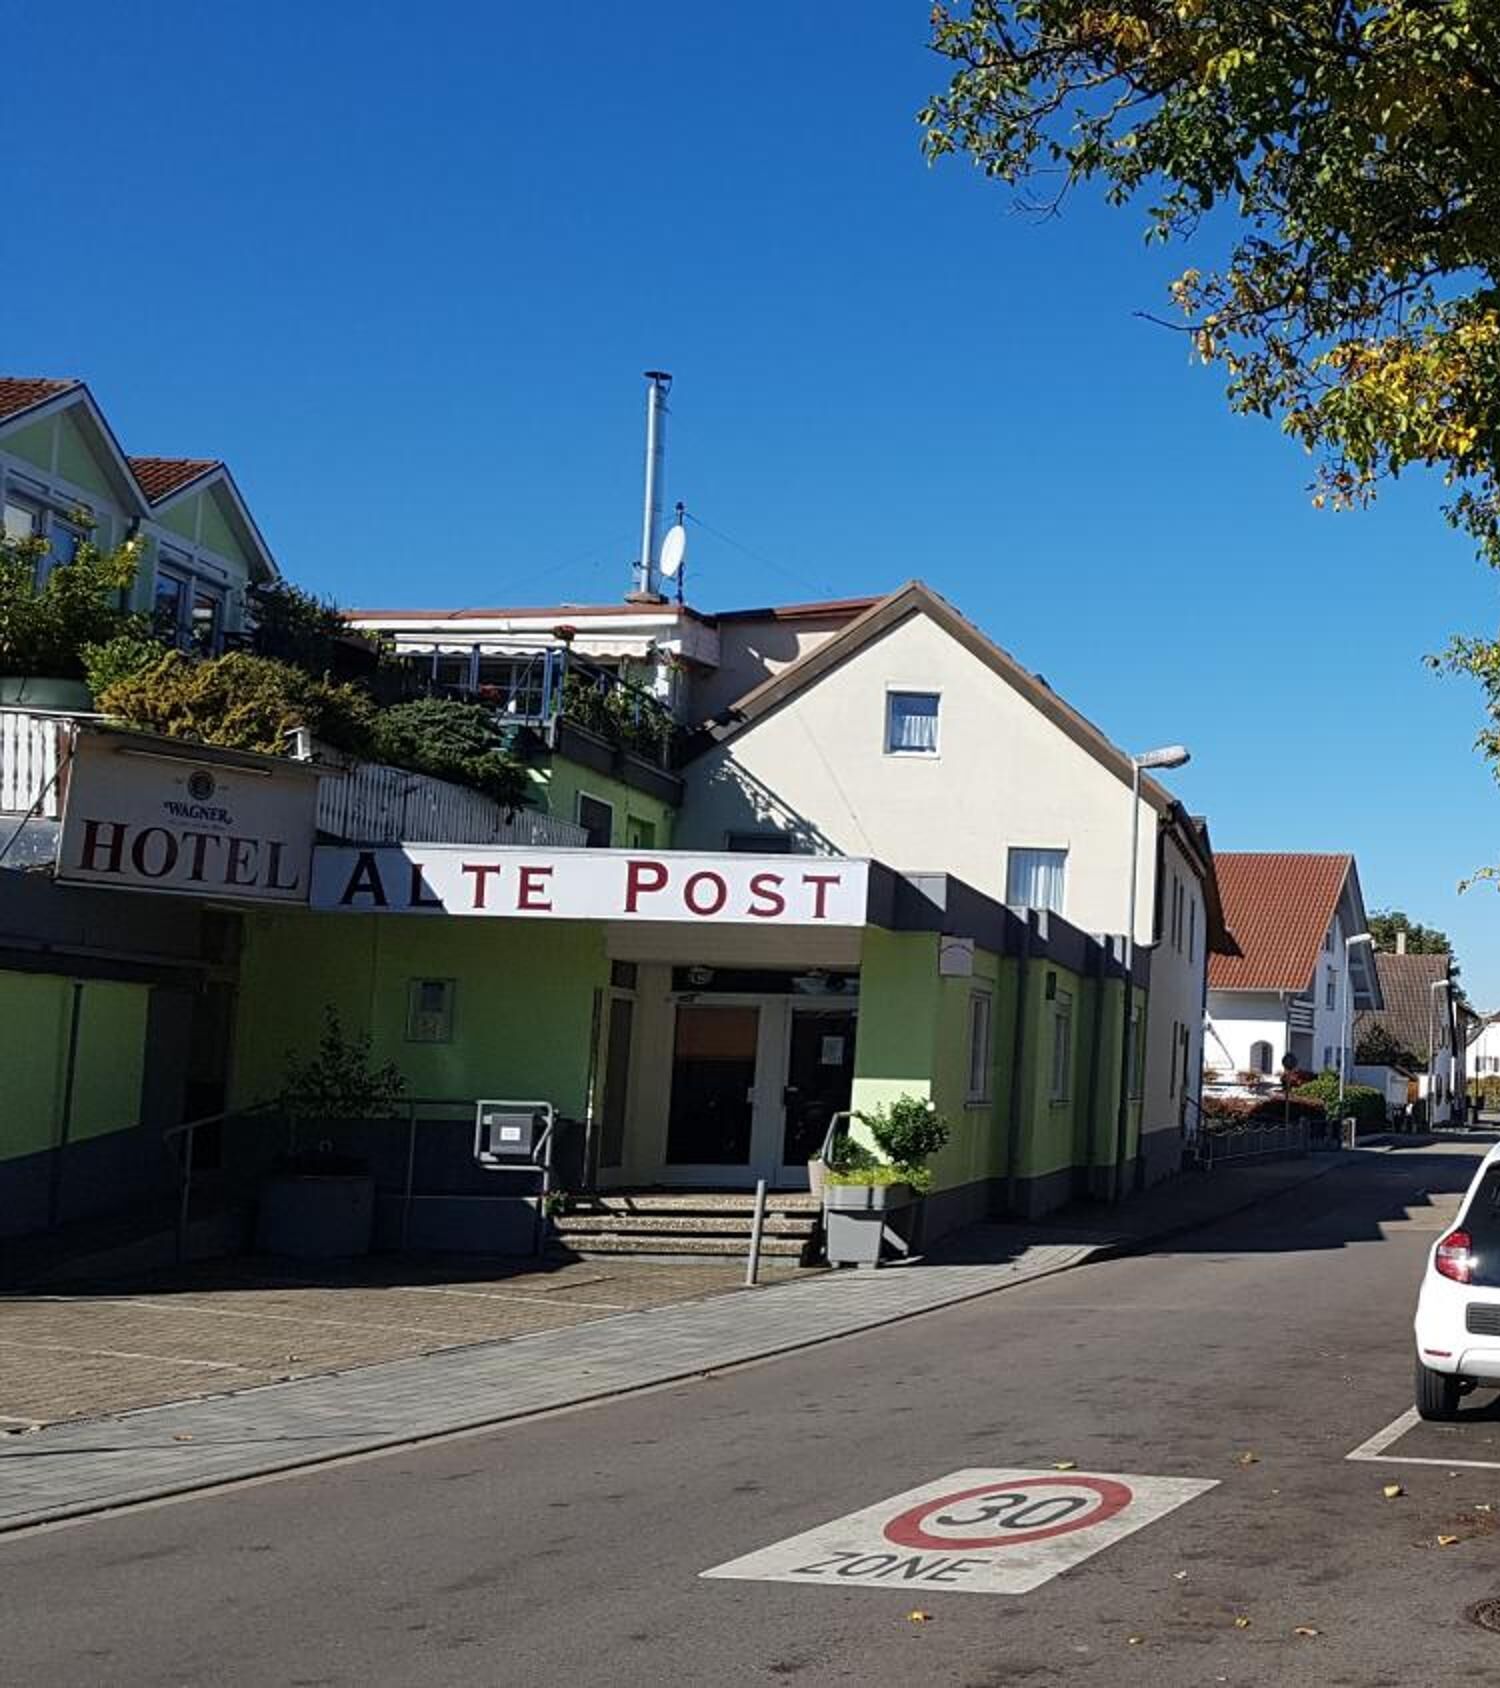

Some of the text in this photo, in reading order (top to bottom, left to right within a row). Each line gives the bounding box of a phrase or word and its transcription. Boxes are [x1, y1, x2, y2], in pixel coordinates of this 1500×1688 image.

[164, 801, 233, 824] WAGNER
[79, 818, 300, 891] HOTEL
[340, 851, 842, 920] ALTE POST
[936, 1492, 1090, 1530] 30
[792, 1551, 992, 1583] ZONE
